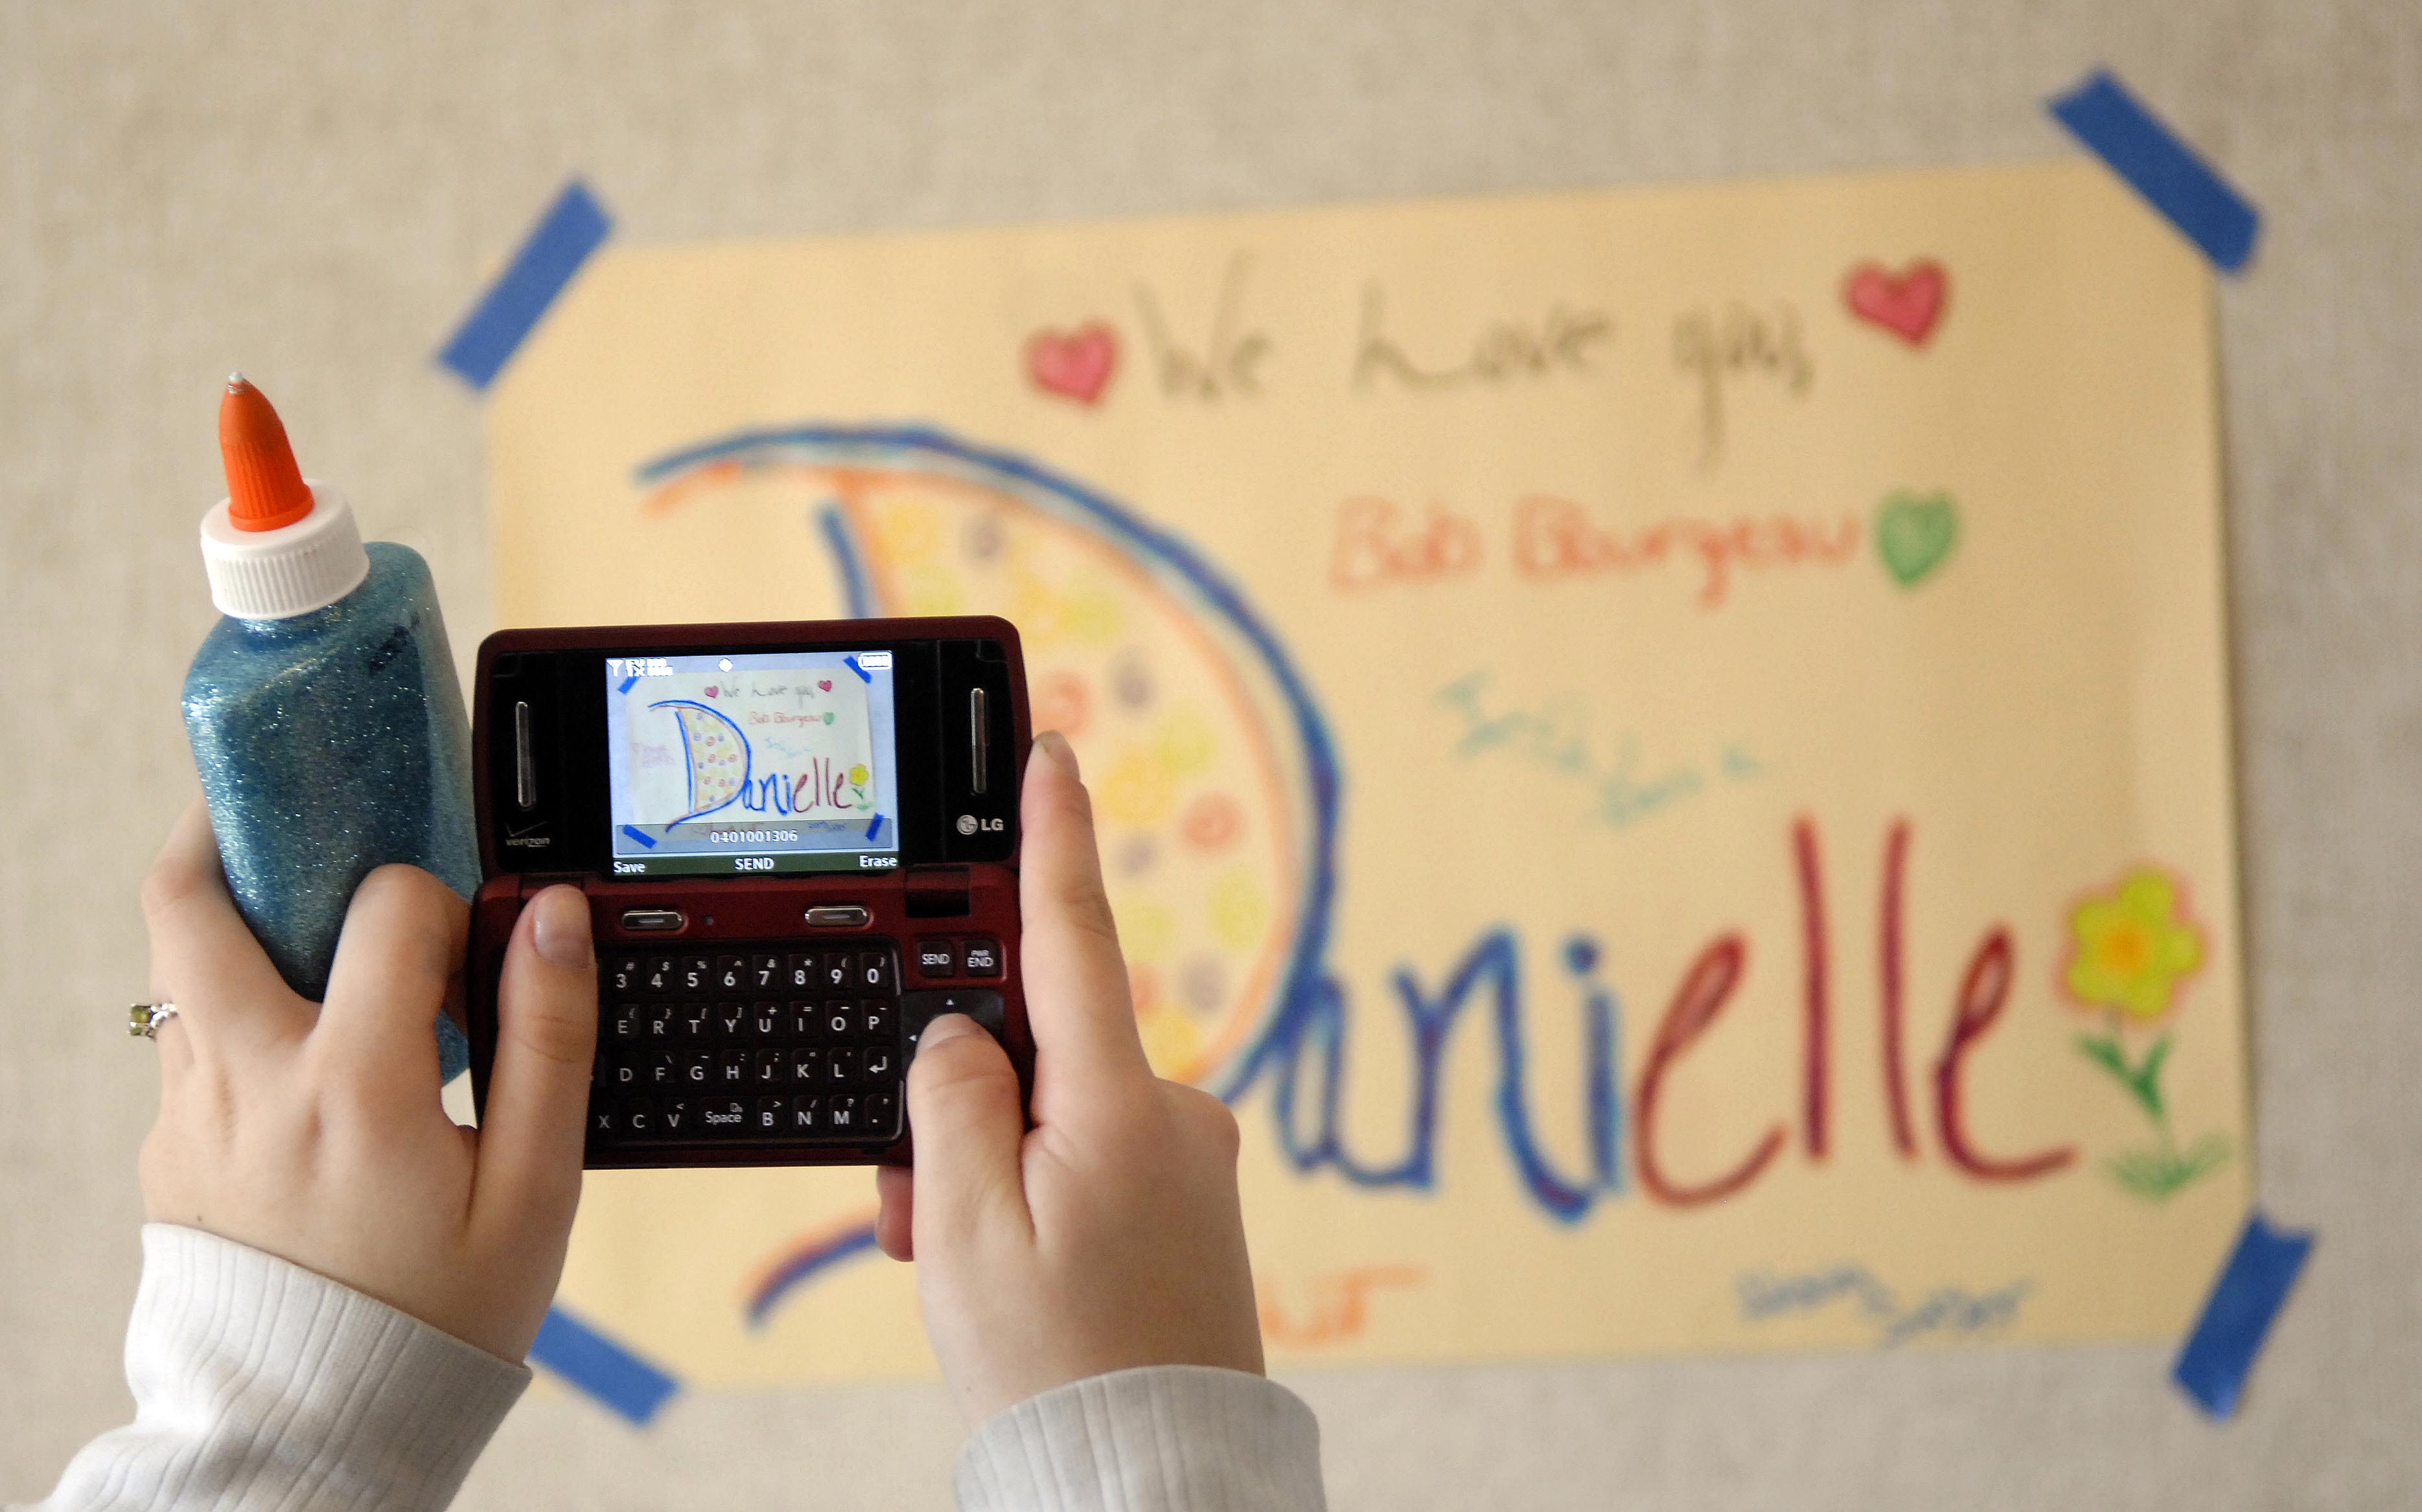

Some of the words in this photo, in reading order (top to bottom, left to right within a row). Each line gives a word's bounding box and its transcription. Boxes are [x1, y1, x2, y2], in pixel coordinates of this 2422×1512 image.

[1131, 249, 1272, 403] We
[1327, 494, 1485, 597] Bob
[648, 699, 853, 832] Danielle
[980, 818, 1004, 831] LG
[710, 830, 799, 843] 0401001306
[614, 862, 645, 873] Save
[735, 857, 775, 870] SEND
[859, 855, 898, 867] Erase
[921, 953, 950, 965] SEND
[967, 957, 994, 967] END
[616, 973, 627, 989] 3
[651, 973, 663, 988] 4
[687, 972, 699, 988] 5
[723, 971, 736, 987] 6
[758, 970, 770, 986] 7
[794, 969, 806, 985] 8
[830, 968, 843, 985] 9
[866, 968, 879, 984] 0
[617, 1020, 628, 1034] E
[652, 1020, 664, 1035] R
[687, 1020, 700, 1034] T
[724, 1019, 737, 1033] Y
[759, 1018, 772, 1033] U
[831, 1016, 846, 1031] O
[868, 1016, 880, 1031] P
[619, 1068, 634, 1082] D
[655, 1067, 665, 1081] F
[689, 1066, 704, 1081] G
[726, 1065, 739, 1080] H
[761, 1065, 772, 1080] J
[796, 1064, 810, 1079] K
[834, 1064, 845, 1079] L
[599, 1114, 611, 1128] X
[632, 1114, 646, 1128] C
[667, 1114, 680, 1128] V
[704, 1110, 743, 1126] Space
[762, 1112, 774, 1127] B
[797, 1110, 813, 1125] N
[833, 1110, 849, 1125] M
